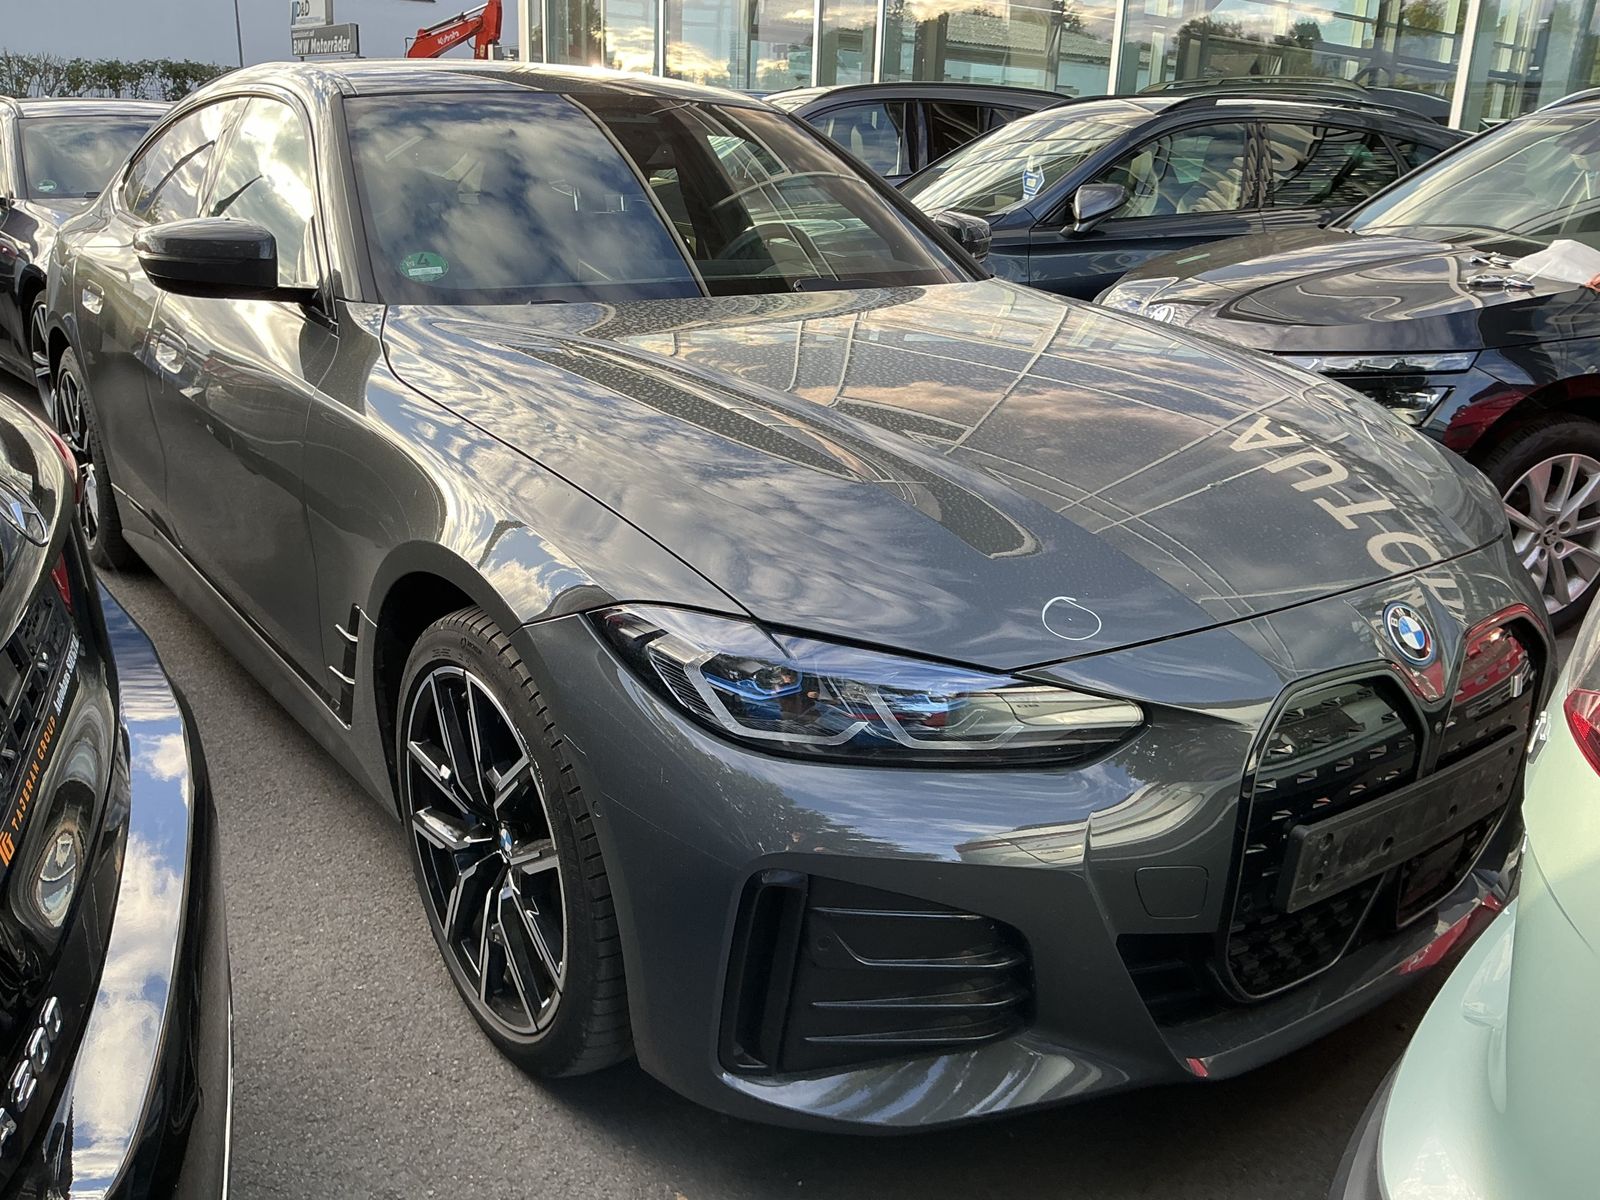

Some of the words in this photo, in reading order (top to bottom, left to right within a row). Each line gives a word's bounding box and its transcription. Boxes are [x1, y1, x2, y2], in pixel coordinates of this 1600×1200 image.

[293, 38, 310, 54] BMW
[310, 35, 351, 53] Motorräder
[1389, 607, 1419, 628] BMW
[11, 763, 40, 831] TAJERAN
[37, 714, 58, 759] GROUP
